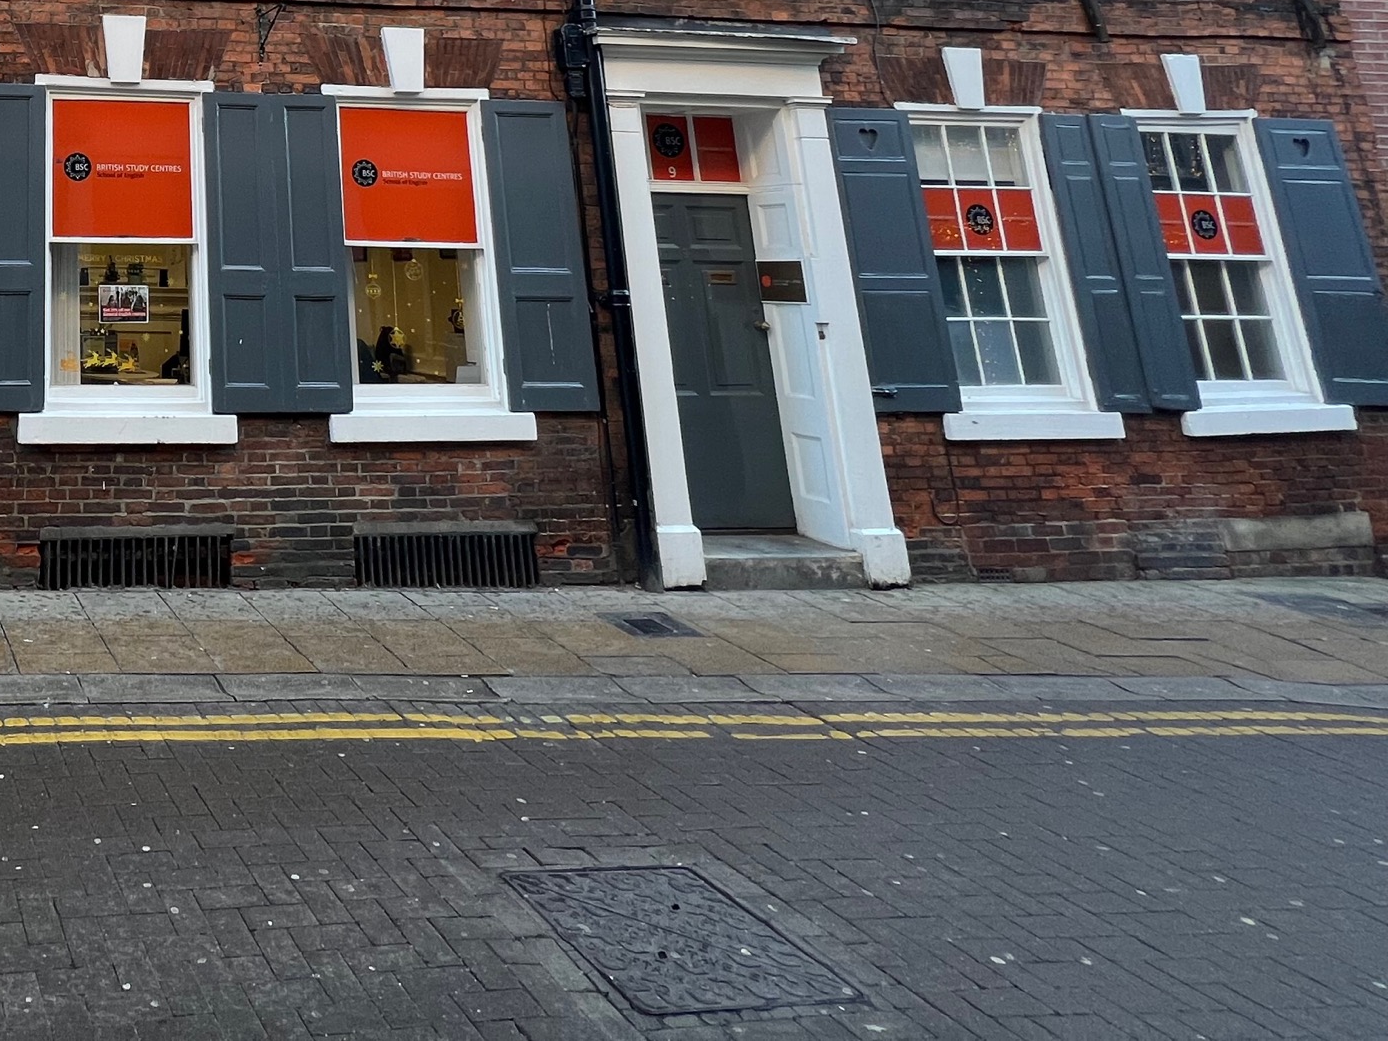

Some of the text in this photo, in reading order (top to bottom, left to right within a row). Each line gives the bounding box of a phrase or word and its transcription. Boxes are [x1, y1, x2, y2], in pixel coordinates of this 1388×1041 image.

[665, 136, 681, 146] BSC
[75, 163, 88, 171] BSC
[96, 163, 182, 173] BRITISH STUDY CENTRES
[362, 169, 375, 177] BSC
[382, 170, 463, 180] BRITISH STUDY CENTRES
[668, 166, 677, 178] 9
[977, 215, 991, 224] BSC
[78, 254, 163, 263] MERRY CHRISTMAS
